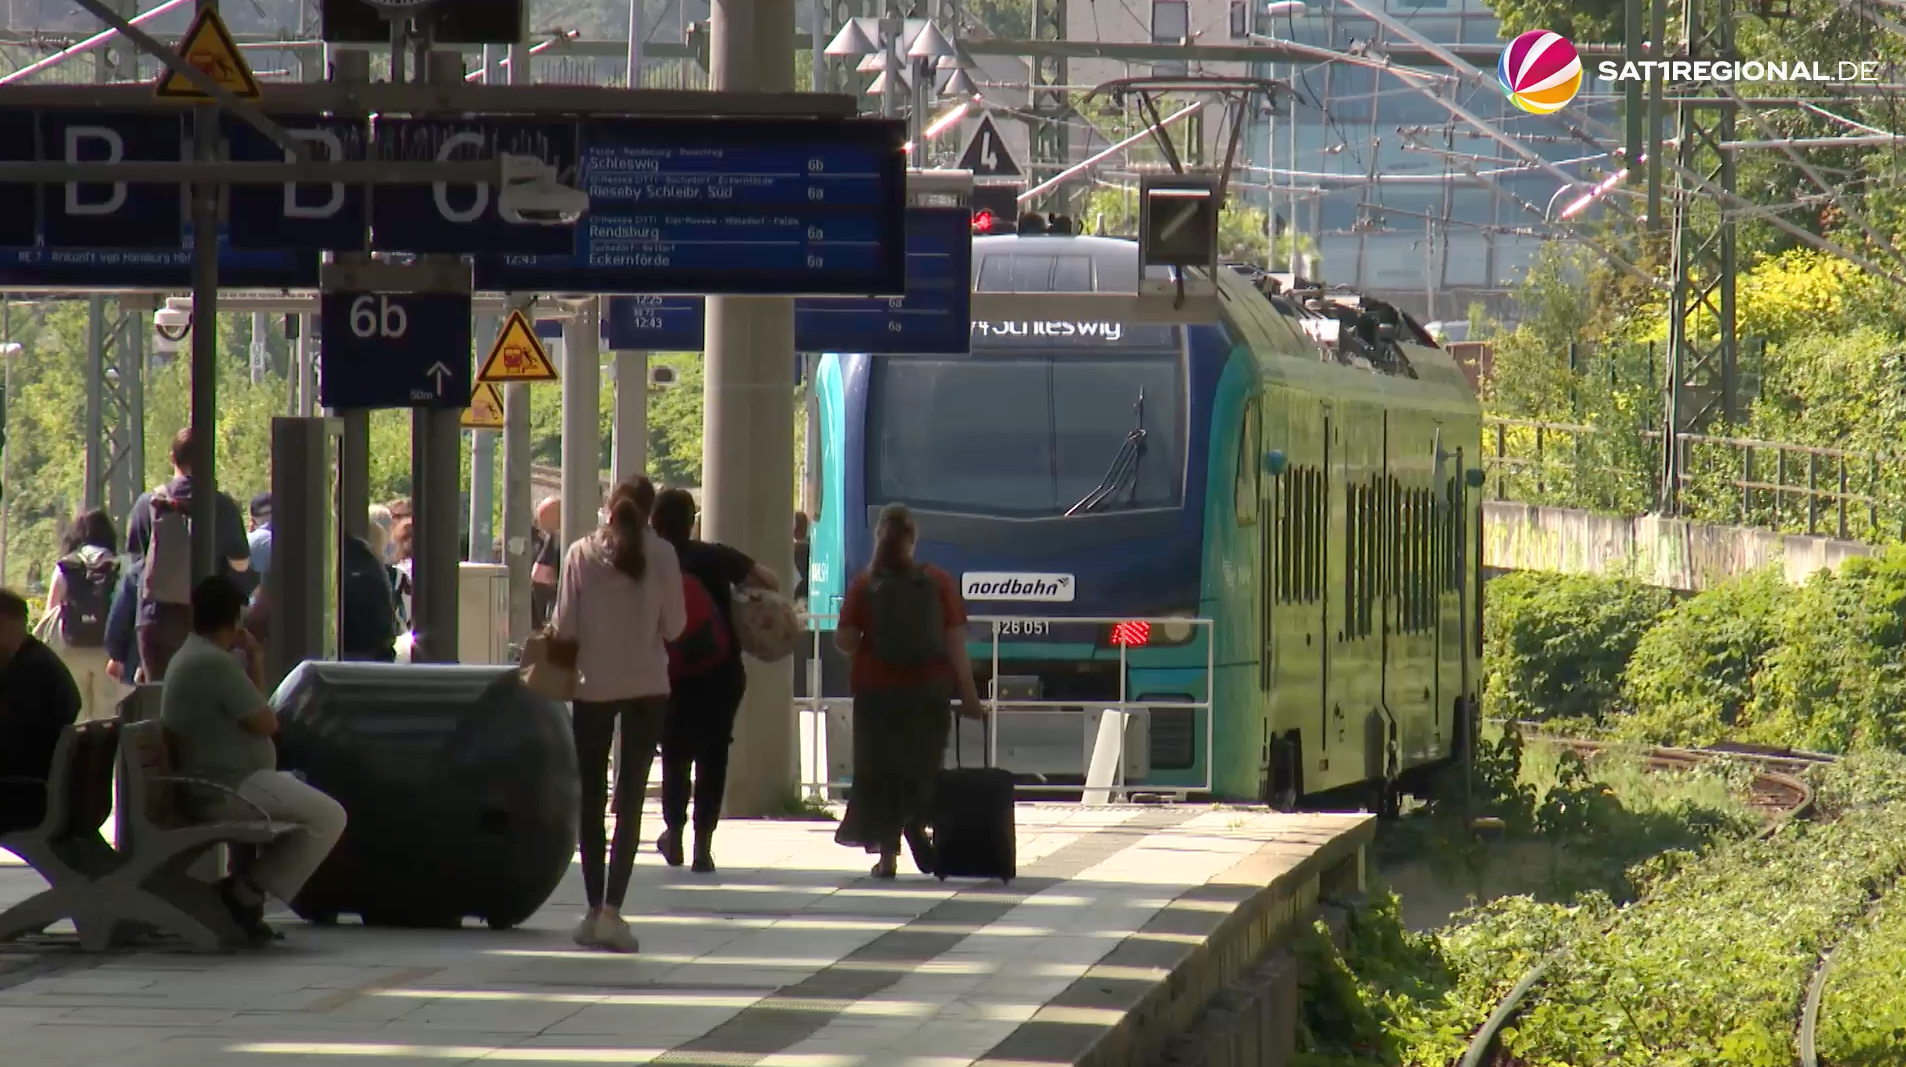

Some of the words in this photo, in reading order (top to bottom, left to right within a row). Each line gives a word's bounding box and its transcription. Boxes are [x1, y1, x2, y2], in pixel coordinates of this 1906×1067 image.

[981, 131, 998, 171] 4
[65, 126, 127, 215] B
[590, 156, 660, 171] Schleswig
[808, 158, 824, 172] 6b
[808, 187, 824, 200] 6a
[589, 225, 660, 239] Rendsburg
[808, 227, 824, 240] 6a
[589, 252, 671, 267] Eckernförde
[808, 255, 824, 268] 6a
[350, 294, 407, 338] 6b
[968, 577, 1058, 596] nordbahn
[1024, 620, 1050, 636] 051
